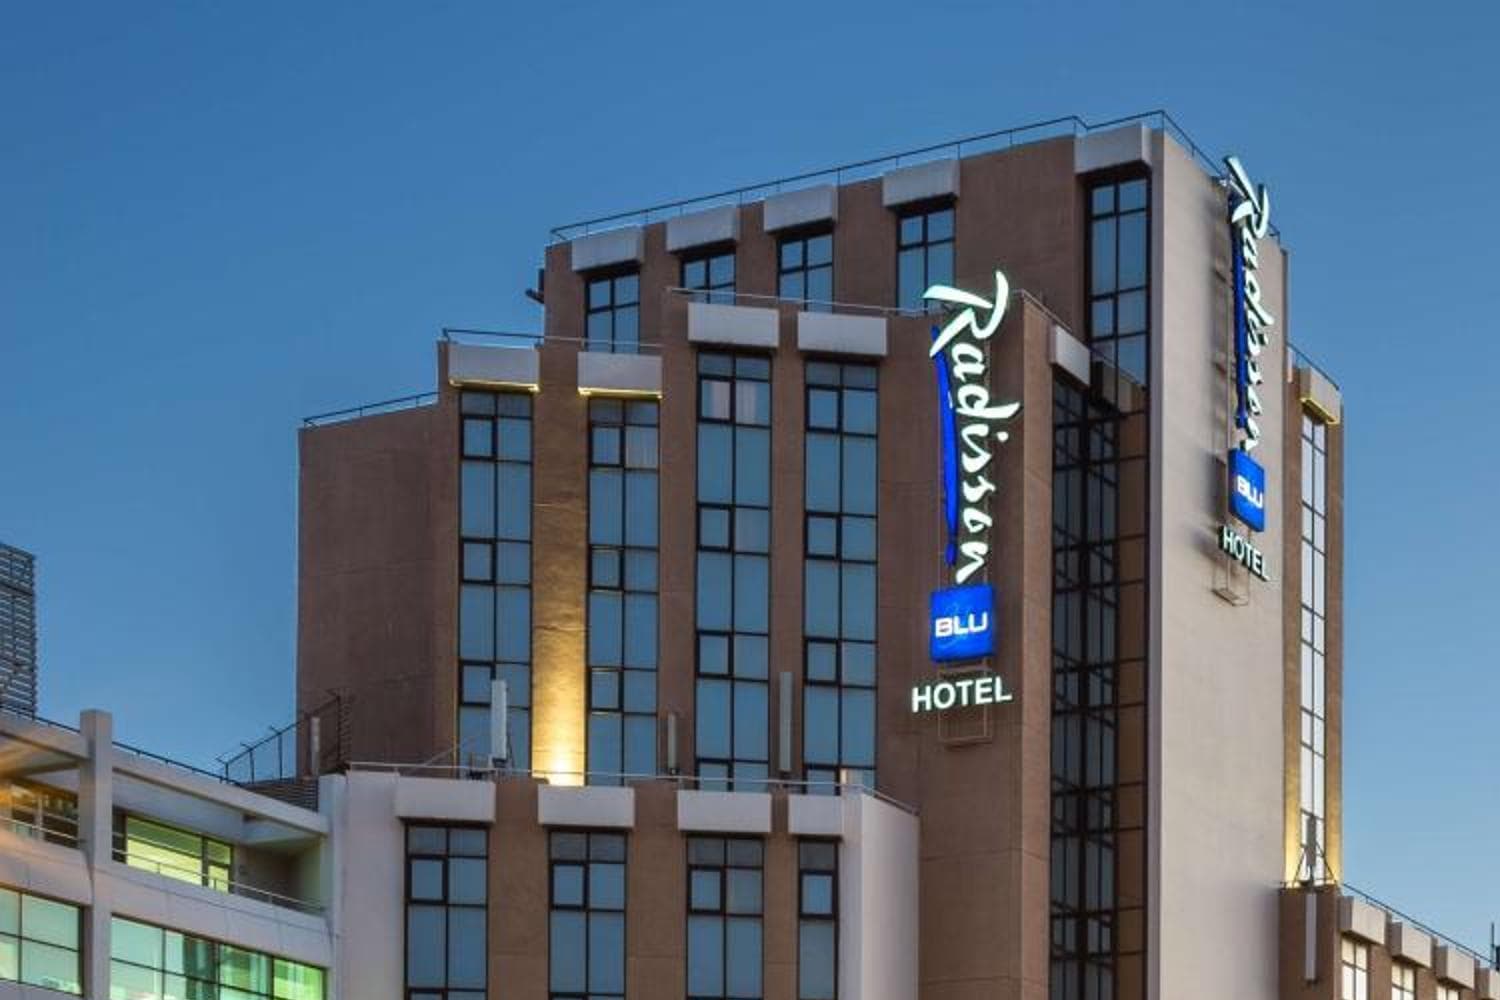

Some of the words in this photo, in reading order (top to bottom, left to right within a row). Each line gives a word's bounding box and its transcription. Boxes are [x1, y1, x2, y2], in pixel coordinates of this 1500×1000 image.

[1225, 155, 1275, 452] Radisson
[922, 270, 1020, 584] Radisson
[1236, 475, 1264, 509] BLU
[1221, 525, 1271, 582] HOTEL
[935, 611, 989, 638] BLU
[911, 676, 1014, 713] HOTEL
